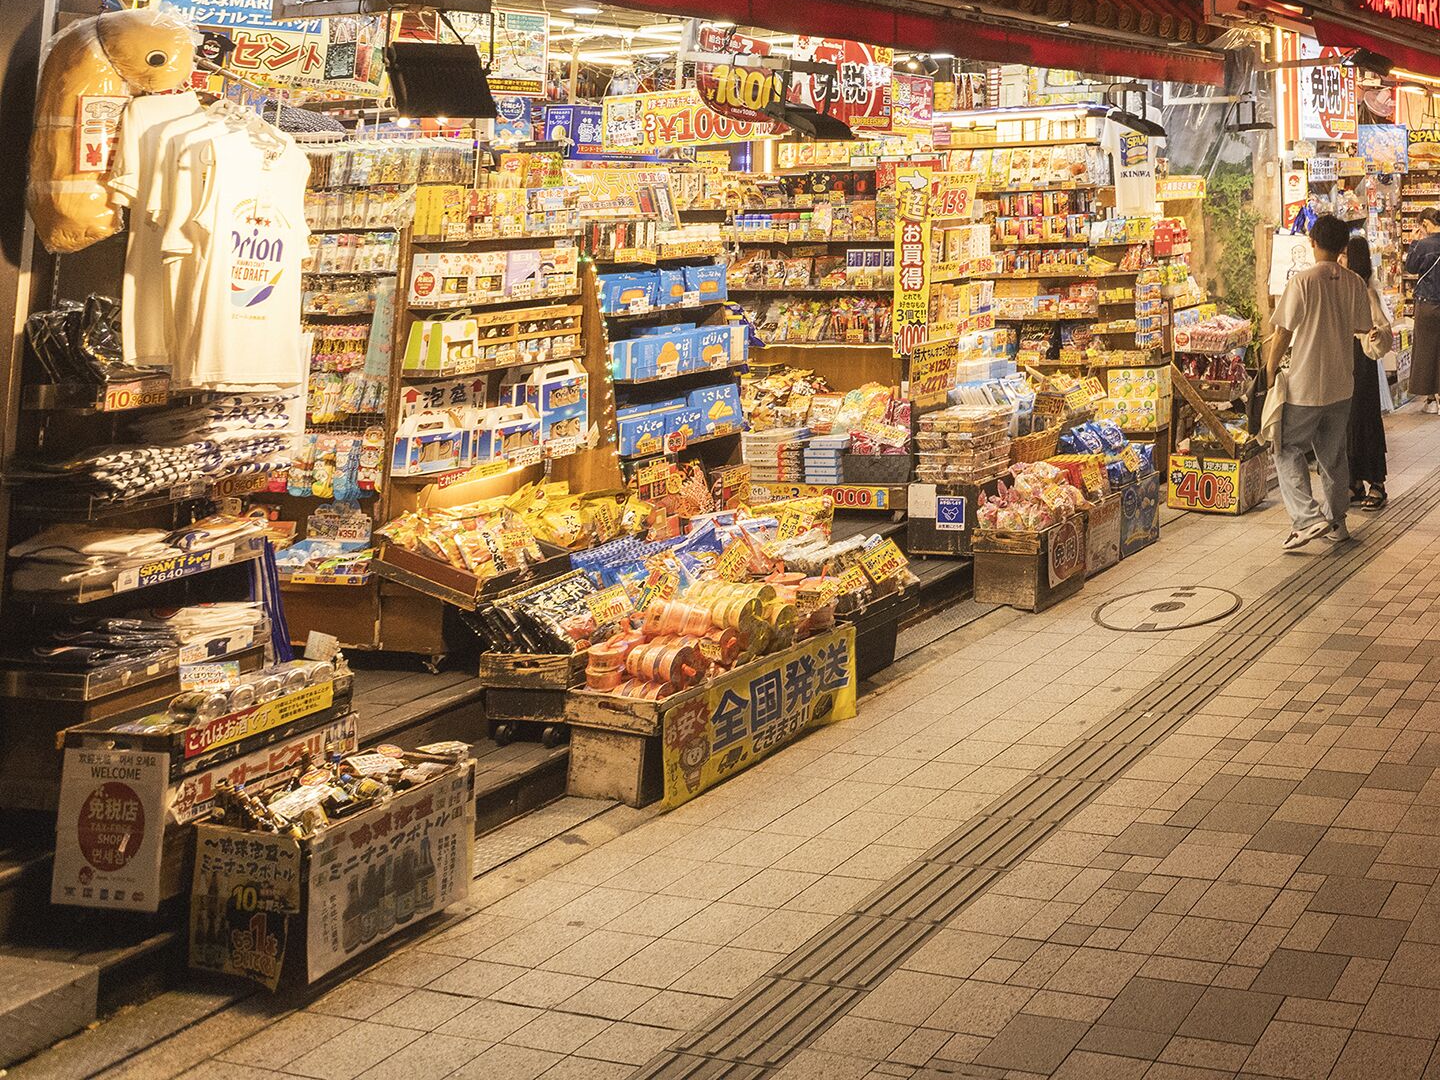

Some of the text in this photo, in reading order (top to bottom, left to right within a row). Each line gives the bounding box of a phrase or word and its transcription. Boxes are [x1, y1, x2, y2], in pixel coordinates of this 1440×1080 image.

[1311, 66, 1341, 115] 免税
[1127, 135, 1148, 148] SPAM
[243, 269, 269, 282] DRAFT
[107, 389, 167, 410] 10%OFF
[423, 383, 466, 409] 泡盛
[139, 558, 177, 578] SPAM
[142, 566, 184, 586] ¥2640
[709, 637, 850, 756] 全国発送
[188, 710, 276, 752] これはお酒です。
[666, 708, 706, 745] お安く
[91, 766, 142, 780] WELCOME
[231, 883, 258, 912] 10
